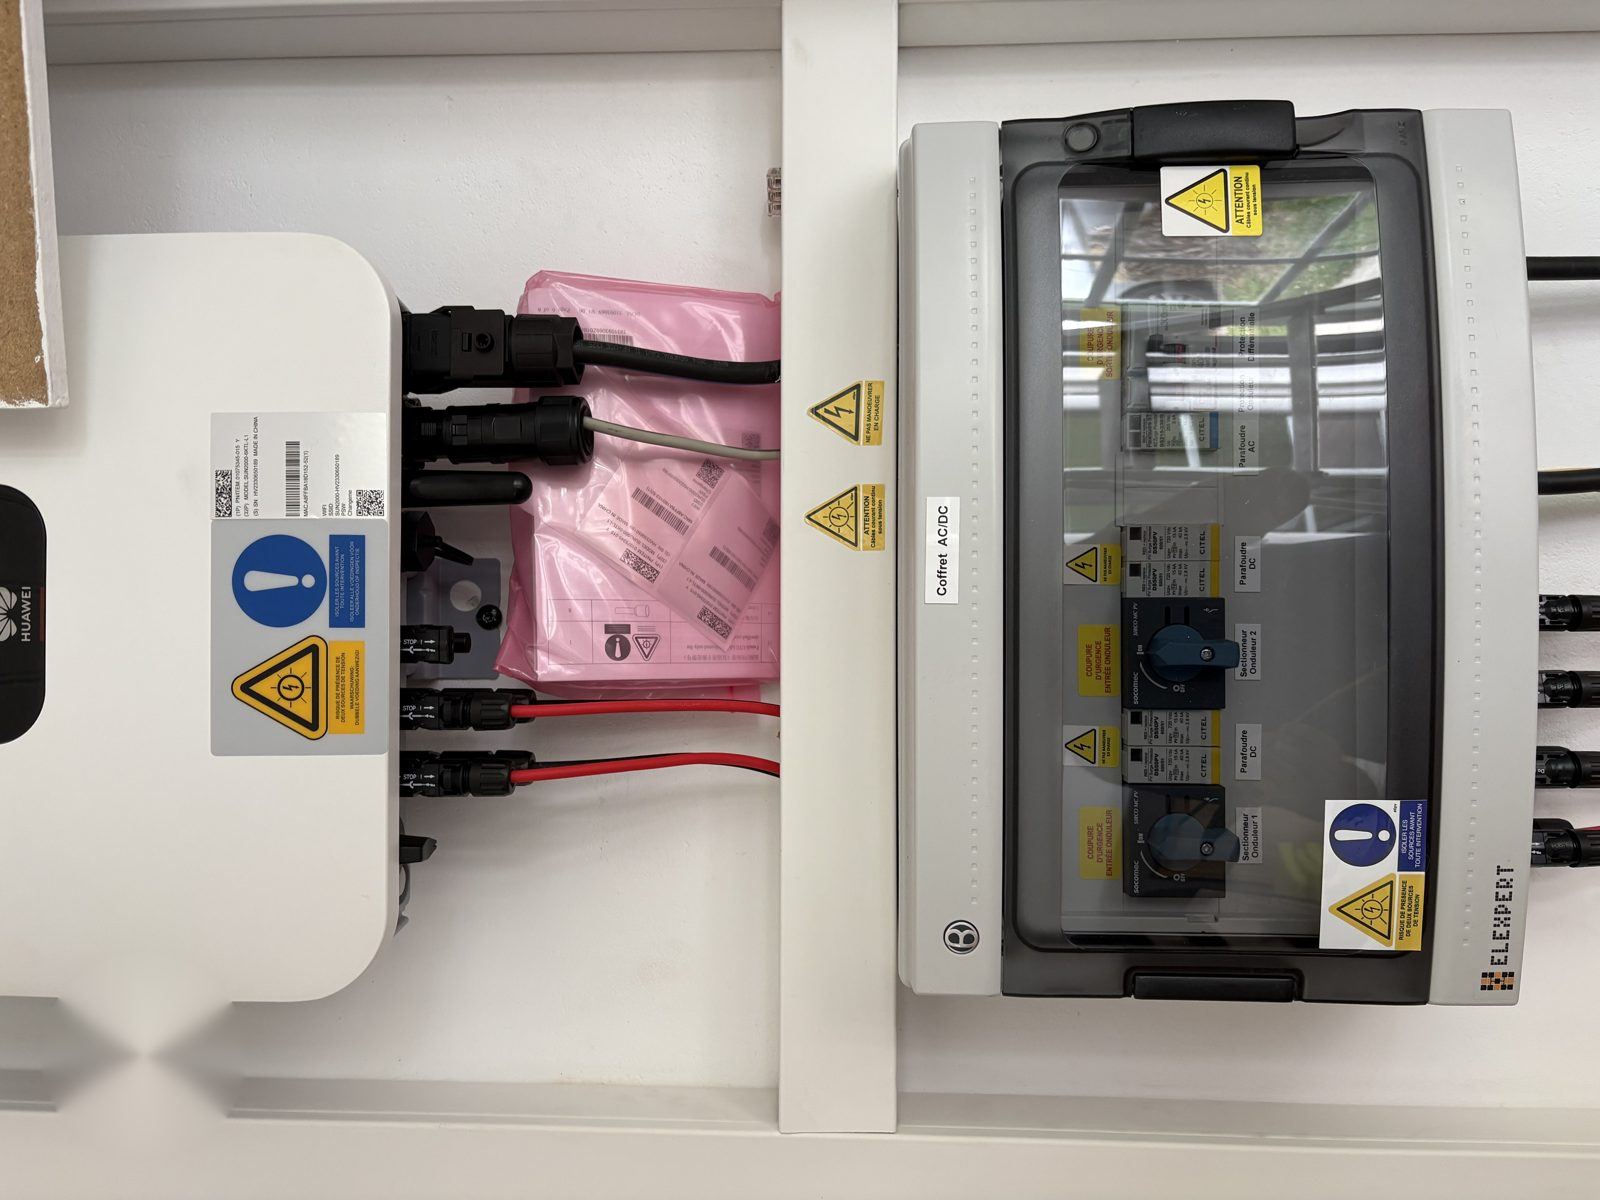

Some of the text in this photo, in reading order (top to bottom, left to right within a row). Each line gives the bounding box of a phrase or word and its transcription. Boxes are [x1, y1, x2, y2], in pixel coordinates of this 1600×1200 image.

[1234, 177, 1244, 224] ATTENTION
[874, 422, 879, 431] EN
[1248, 441, 1255, 452] AC
[937, 506, 948, 596] Coffret AC/DC
[1249, 558, 1256, 569] DC
[21, 586, 31, 642] HUAWEI
[1102, 666, 1111, 693] ENTRÉE
[1250, 746, 1257, 758] DC
[1490, 865, 1514, 965] ELEXPERT
